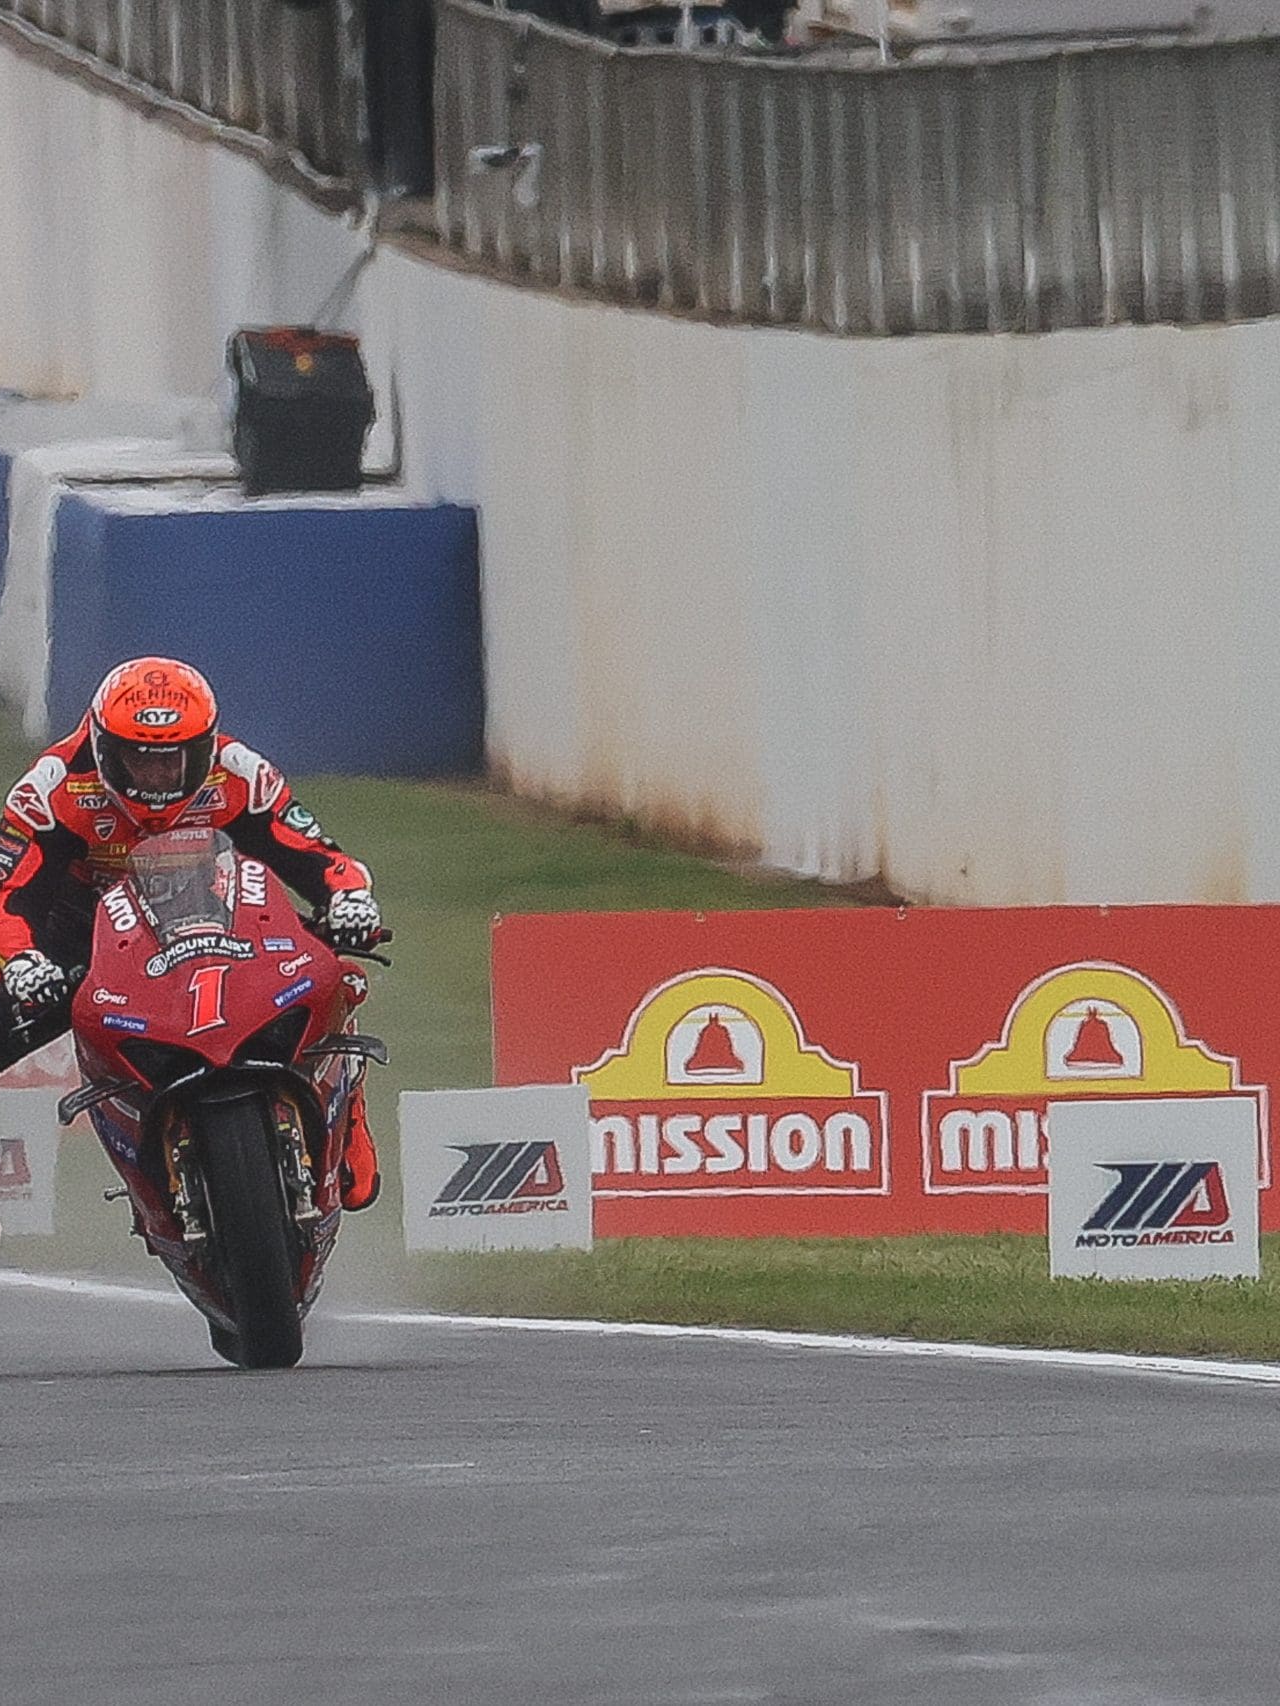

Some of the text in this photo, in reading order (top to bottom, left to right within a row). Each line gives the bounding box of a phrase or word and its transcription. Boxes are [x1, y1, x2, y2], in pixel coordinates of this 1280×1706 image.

[239, 860, 266, 906] KATO
[102, 885, 138, 932] KATO
[166, 936, 217, 961] MOUNT
[187, 965, 230, 1036] 1
[428, 1200, 569, 1218] MOTOAMERICA
[1074, 1230, 1234, 1249] MOTOAMERICA
